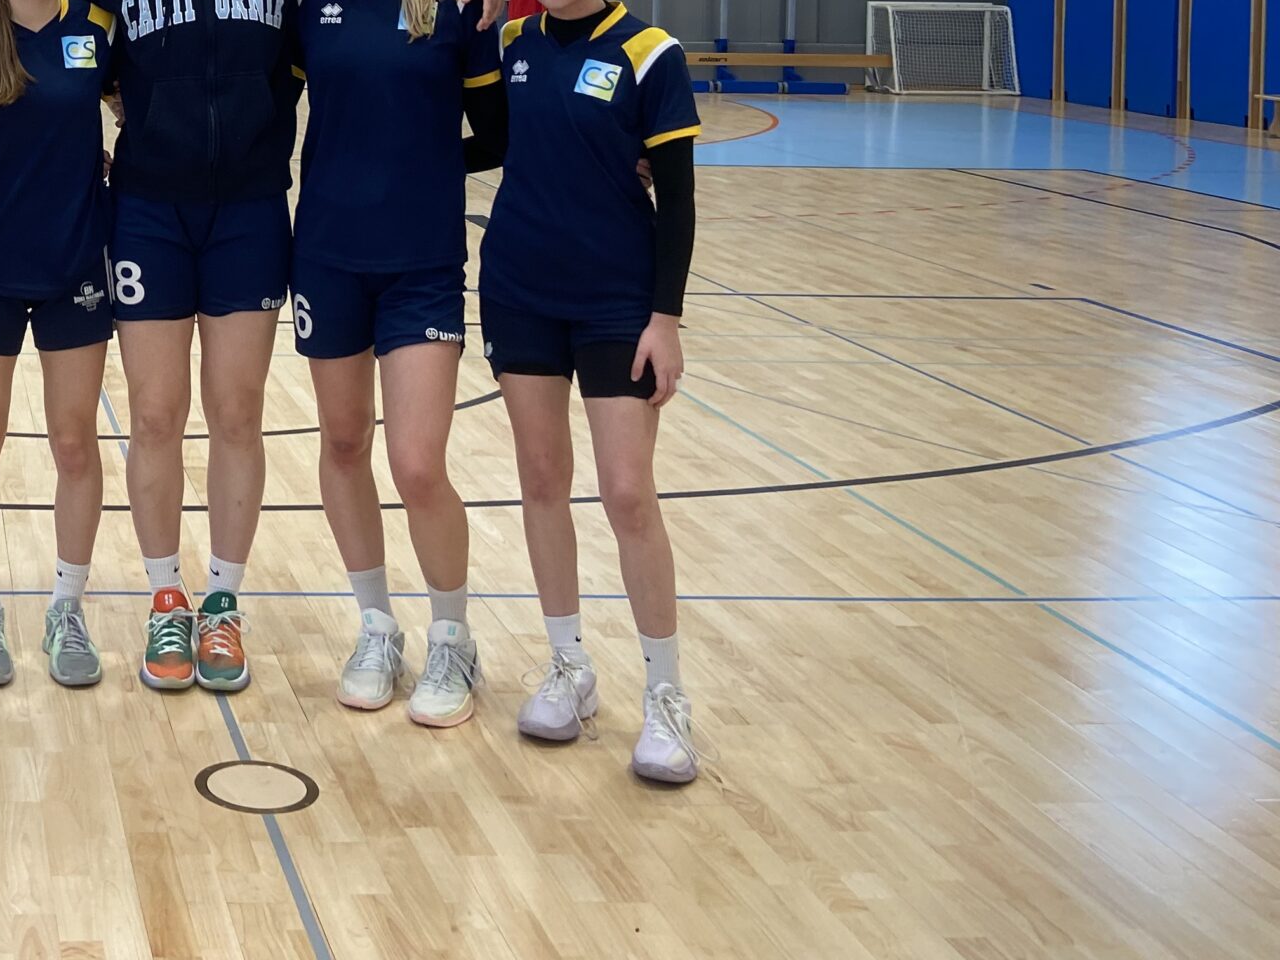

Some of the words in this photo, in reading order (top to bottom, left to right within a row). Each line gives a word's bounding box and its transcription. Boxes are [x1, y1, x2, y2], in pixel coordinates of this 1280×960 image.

[66, 41, 95, 60] CS
[582, 66, 618, 91] CS
[115, 260, 145, 305] 8
[293, 293, 313, 339] 6
